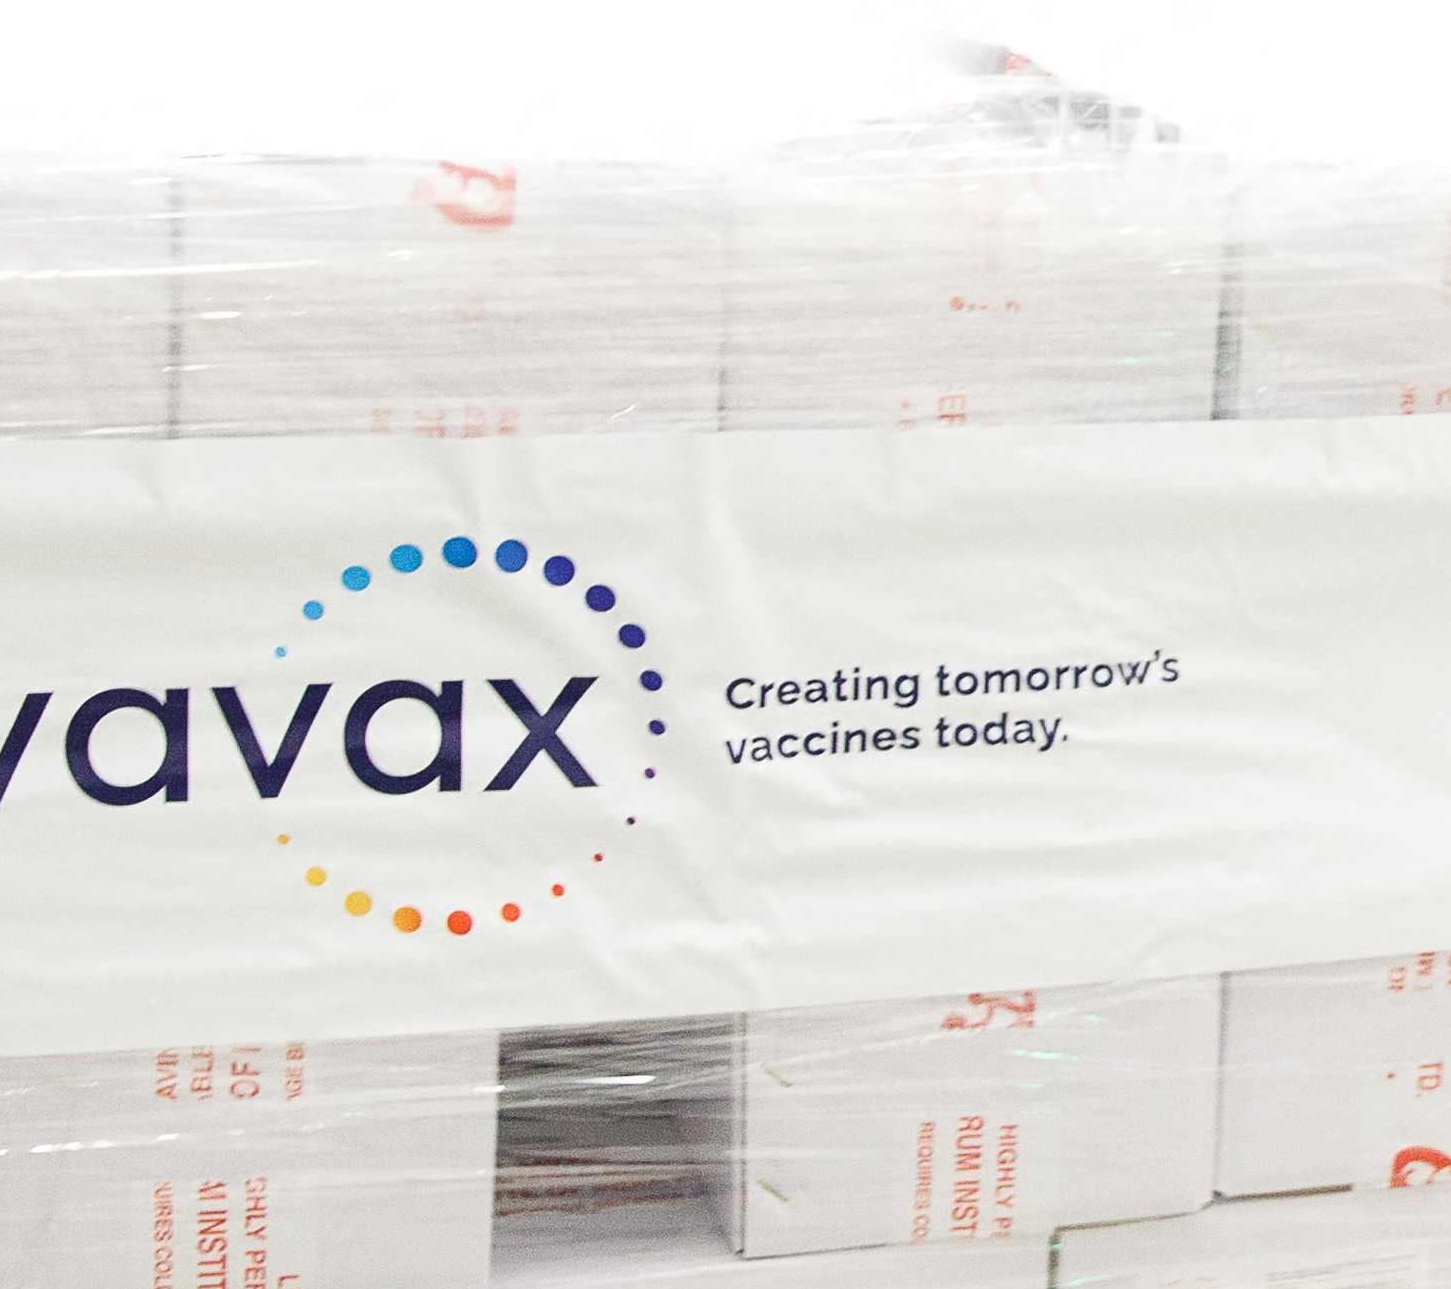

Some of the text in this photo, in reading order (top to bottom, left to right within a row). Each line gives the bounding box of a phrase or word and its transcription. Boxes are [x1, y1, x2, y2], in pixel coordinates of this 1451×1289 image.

[725, 649, 1180, 710] Creating tomorrow's
[725, 711, 1069, 765] vaccines today.
[228, 1061, 261, 1101] OF
[952, 1114, 986, 1173] RUM
[993, 1123, 1020, 1209] HIGHLY
